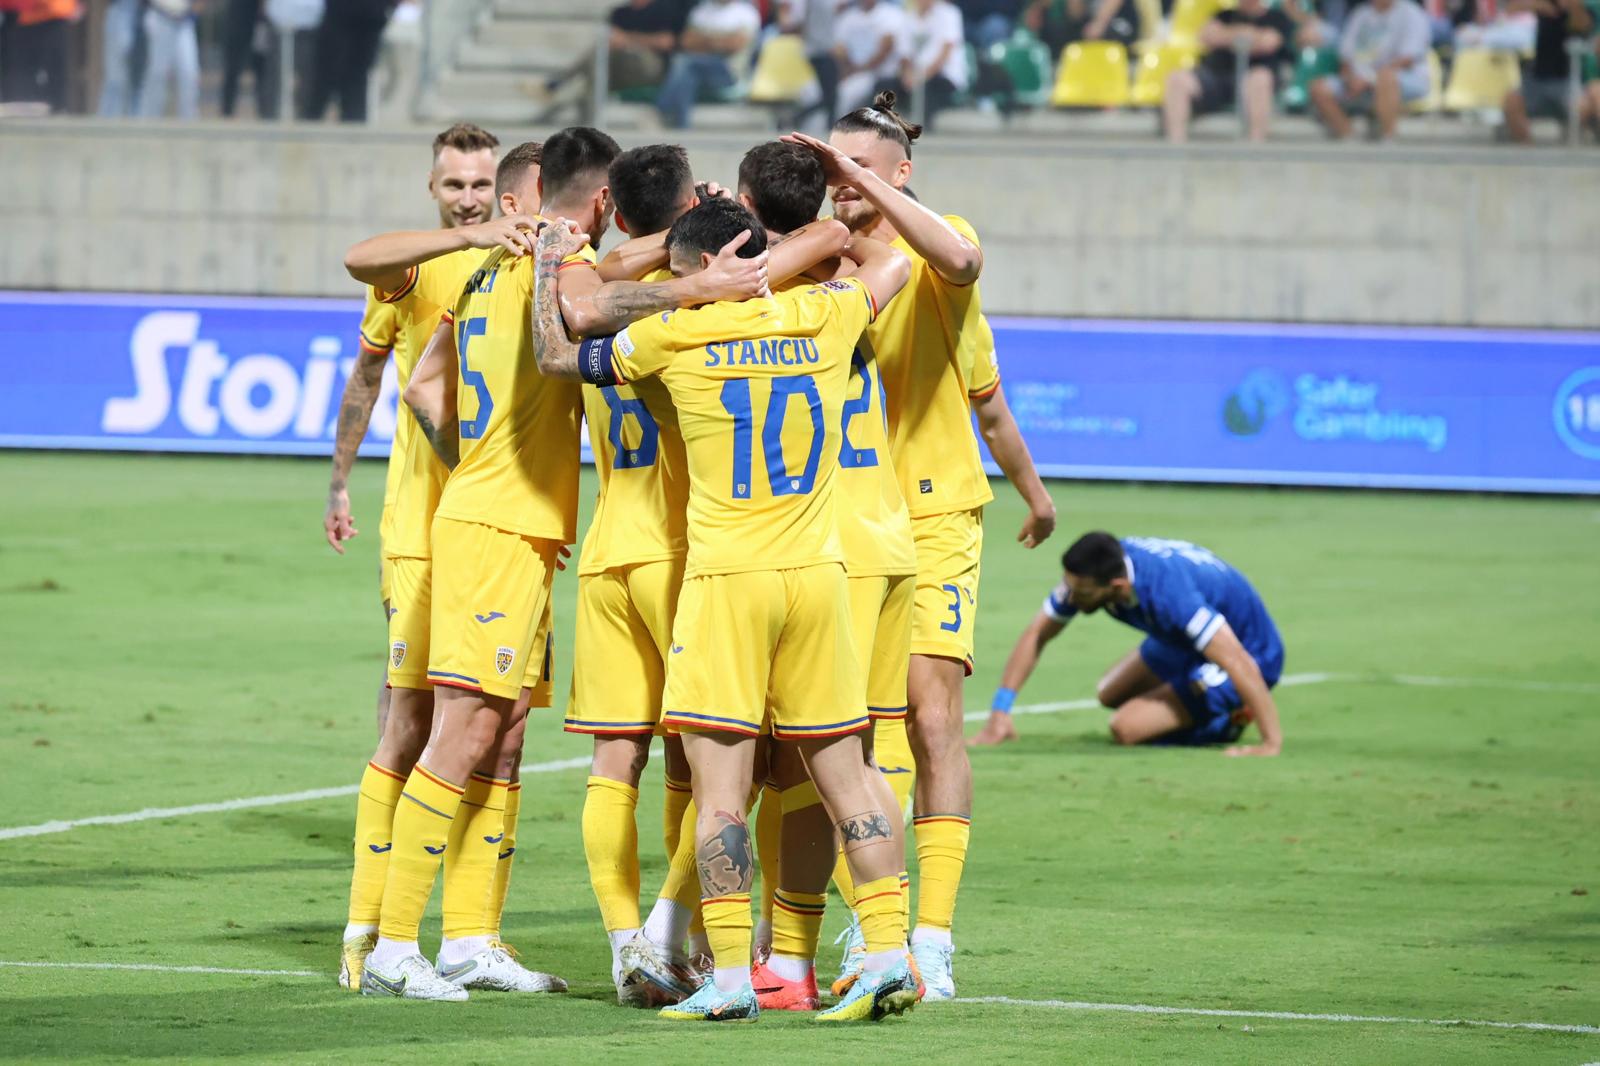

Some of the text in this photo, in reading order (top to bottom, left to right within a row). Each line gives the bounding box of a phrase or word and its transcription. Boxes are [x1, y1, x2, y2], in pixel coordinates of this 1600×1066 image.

[705, 338, 819, 367] STANCIU
[720, 375, 825, 499] 10
[838, 346, 879, 468] 2
[940, 583, 962, 633] 3
